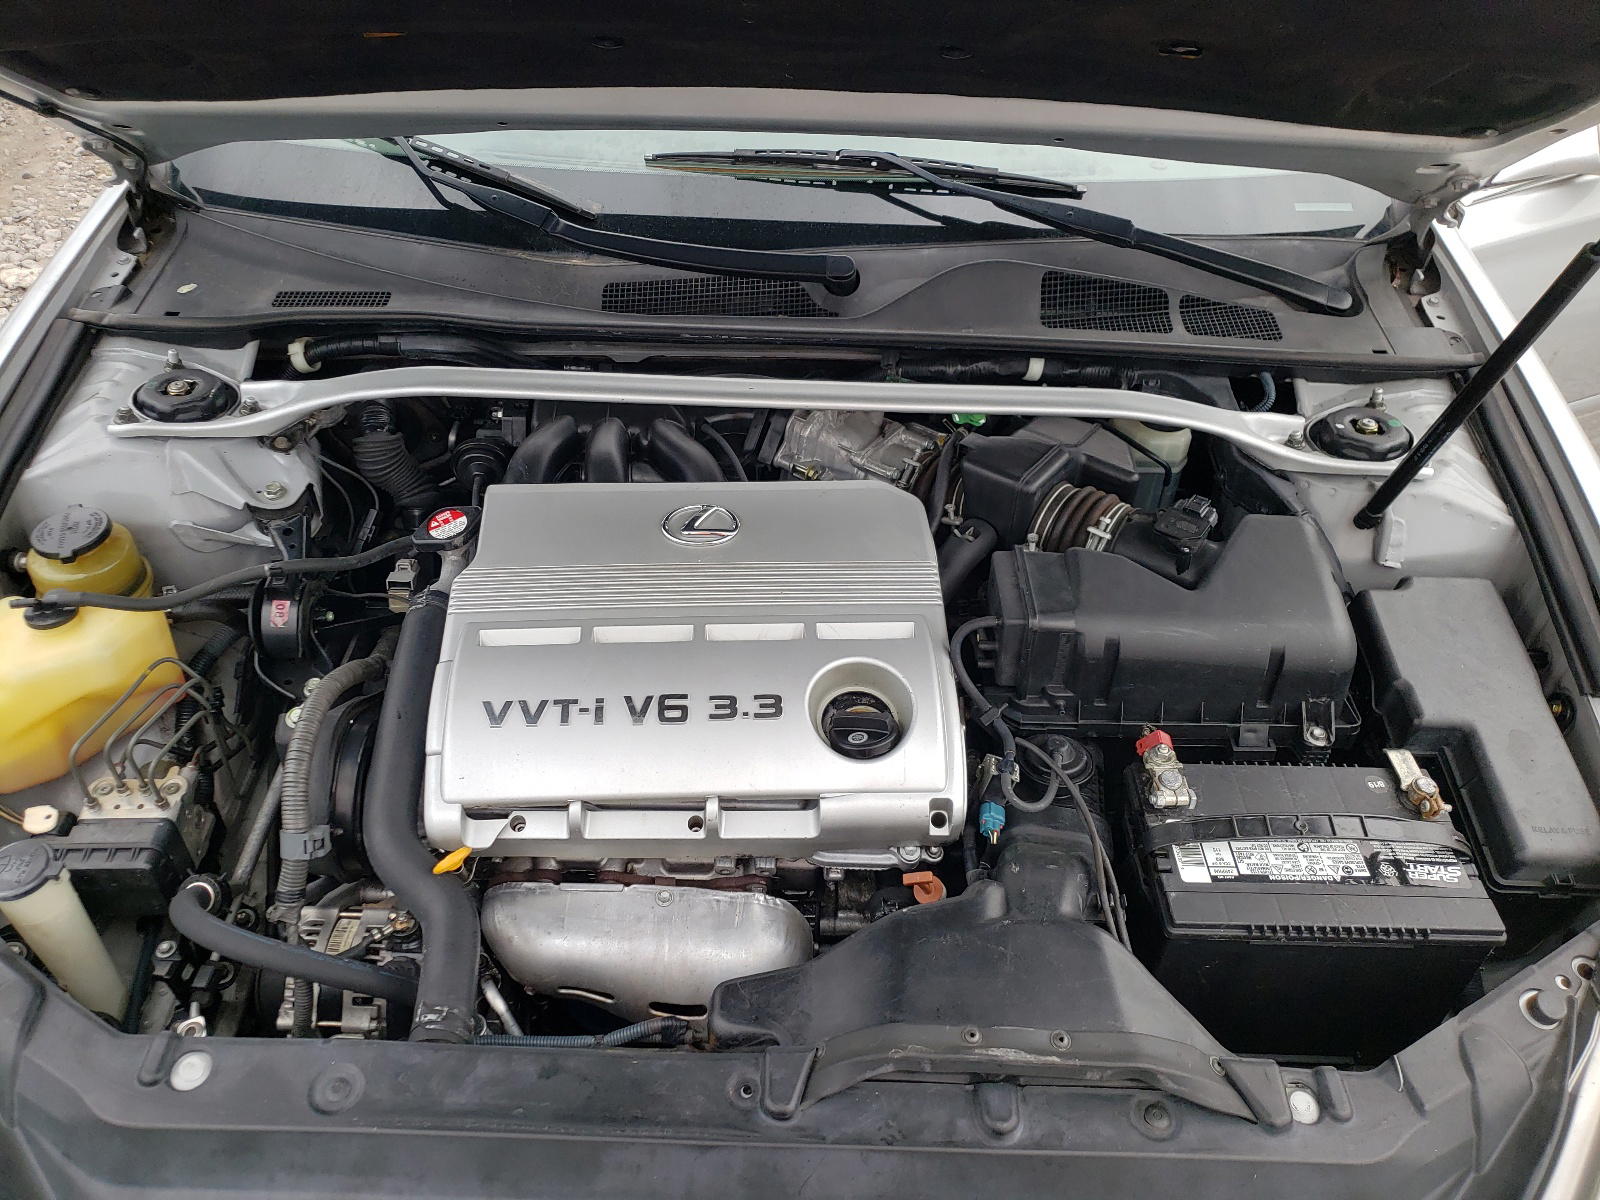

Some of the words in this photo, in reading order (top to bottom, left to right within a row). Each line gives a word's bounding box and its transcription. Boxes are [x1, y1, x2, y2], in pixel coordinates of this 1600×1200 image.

[482, 698, 606, 728] VVT-i
[623, 692, 690, 726] V6
[707, 692, 783, 722] 3.3
[1403, 863, 1461, 877] START
[1407, 871, 1459, 883] SUPER
